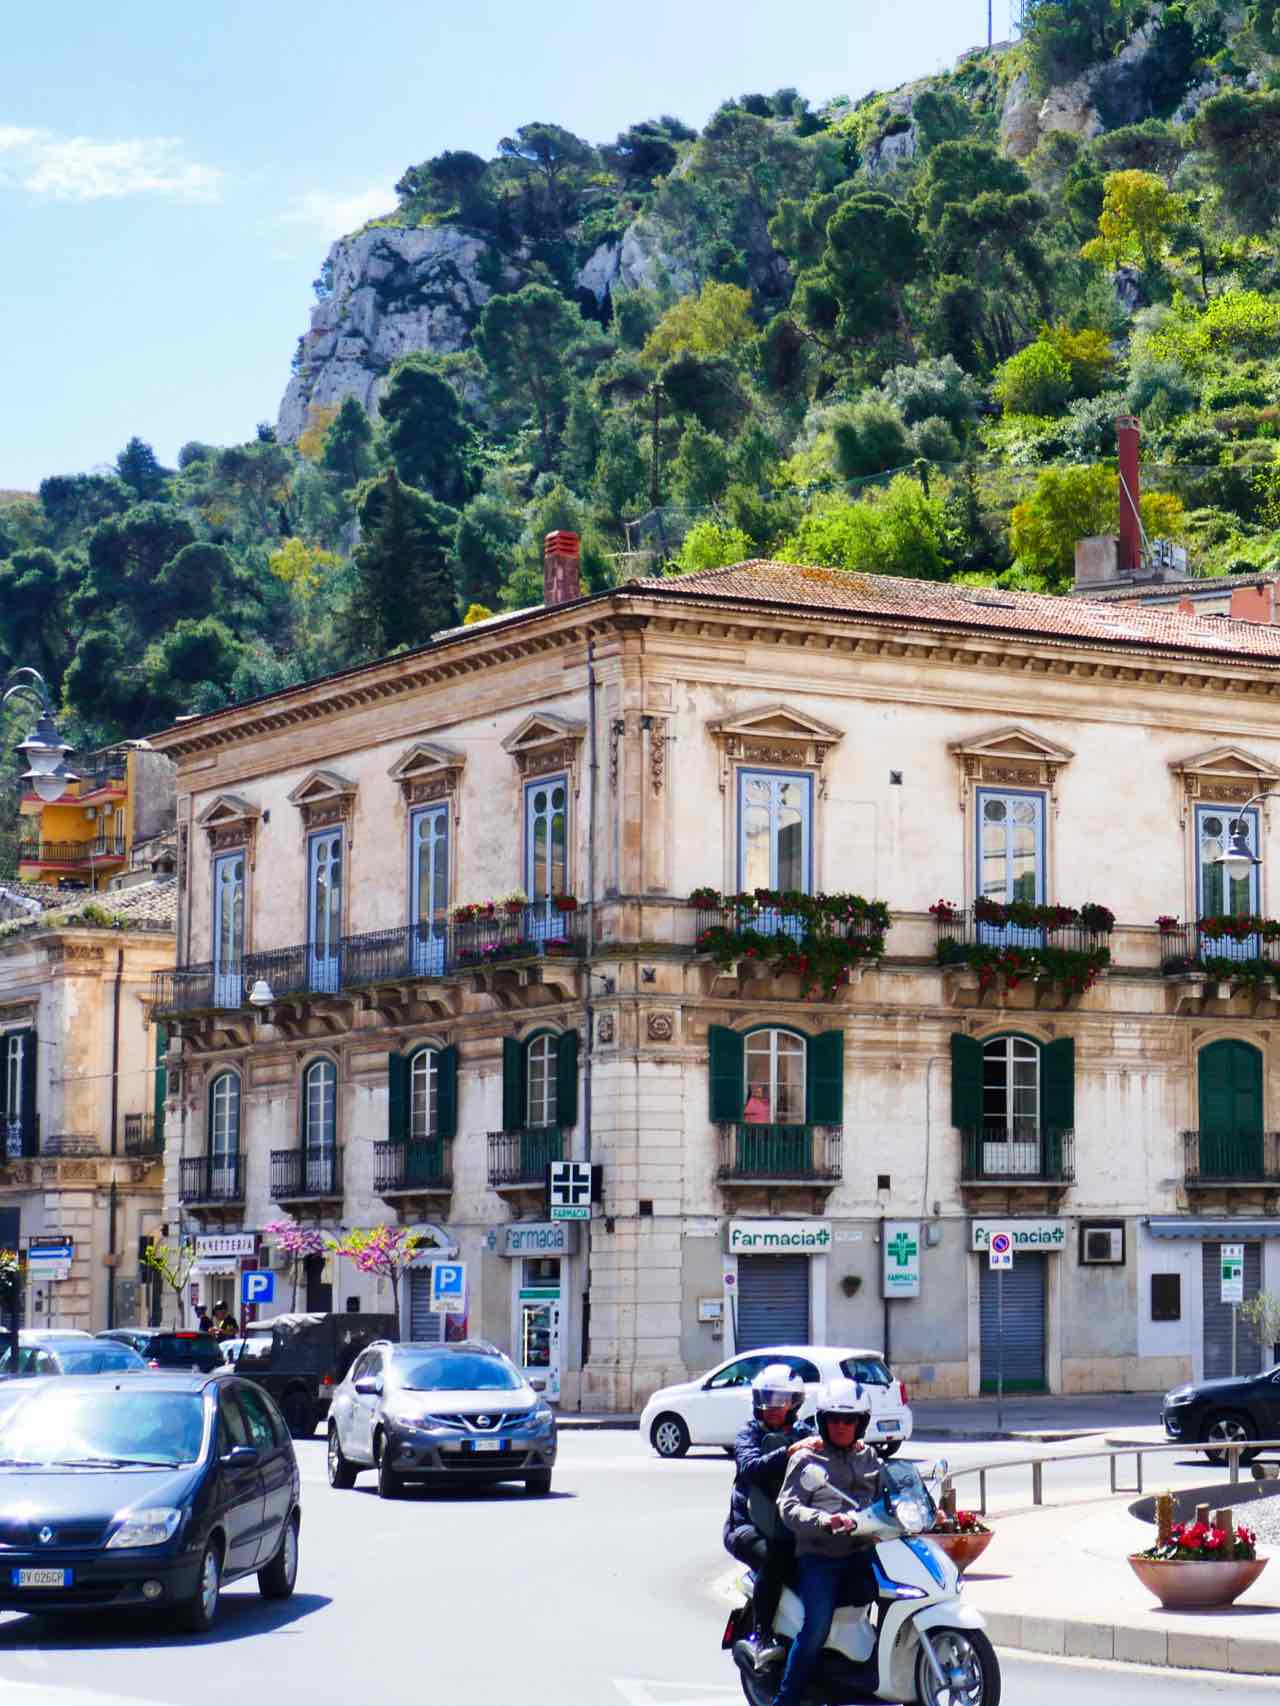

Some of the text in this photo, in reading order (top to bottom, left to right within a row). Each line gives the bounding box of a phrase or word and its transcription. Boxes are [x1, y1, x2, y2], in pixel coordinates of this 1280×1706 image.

[553, 1208, 588, 1217] FARMACIA
[505, 1229, 564, 1248] farmacia
[732, 1229, 816, 1246] farmacia
[249, 1275, 267, 1300] P
[440, 1269, 457, 1289] P
